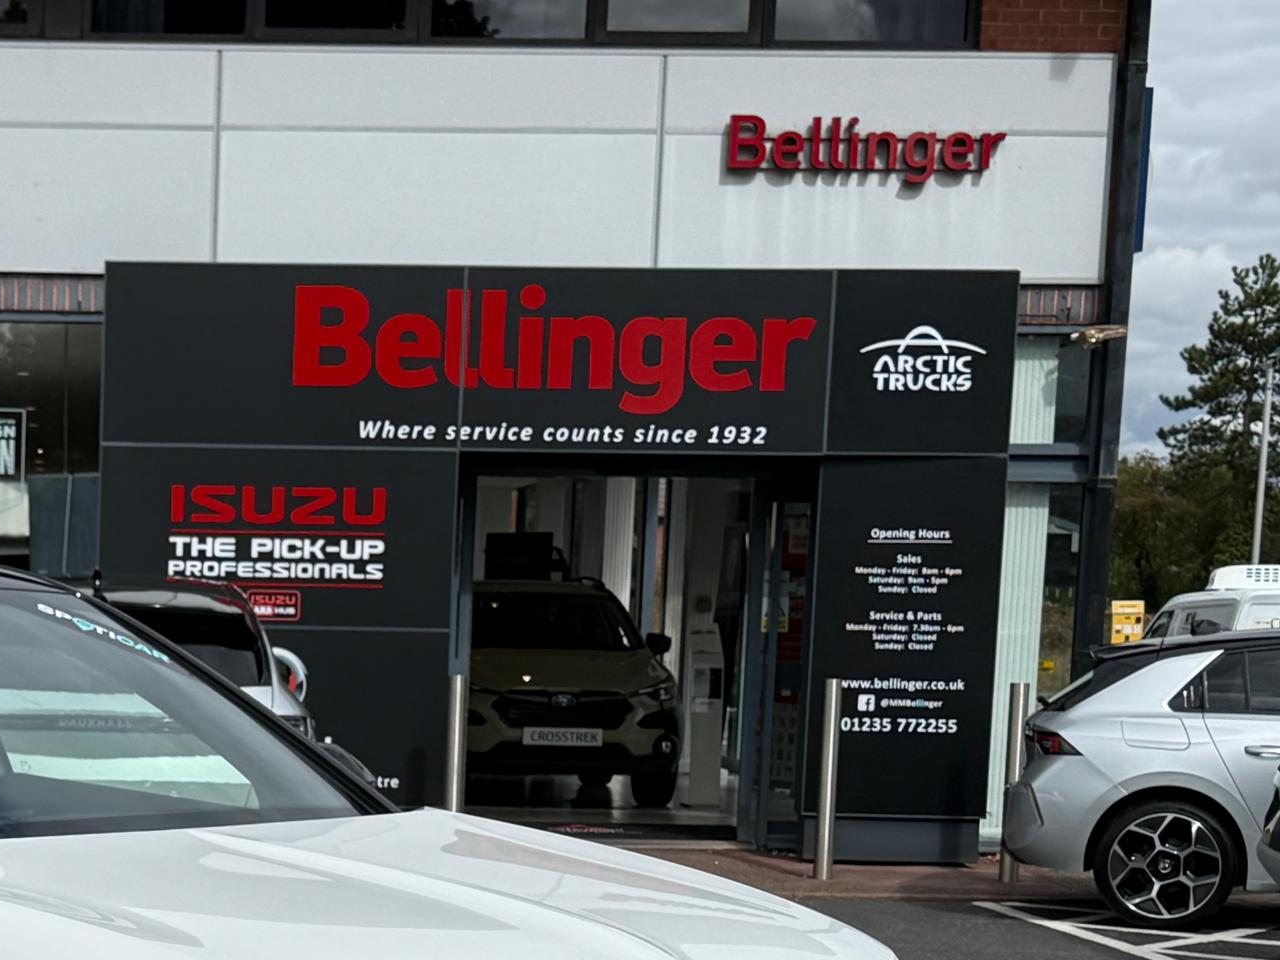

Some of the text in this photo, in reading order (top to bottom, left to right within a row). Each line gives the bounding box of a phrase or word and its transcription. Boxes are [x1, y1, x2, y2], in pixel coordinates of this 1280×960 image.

[726, 114, 1007, 183] Bellinger
[292, 284, 816, 415] Bellinger
[873, 354, 972, 373] ARCTIC
[872, 373, 972, 392] TRUCKS
[359, 420, 767, 445] Where service counts since 1932
[171, 484, 387, 526] ISUZU
[870, 527, 951, 540] Opening Hours
[169, 536, 386, 560] THE PICK-UP
[896, 553, 922, 564] Sales
[167, 560, 384, 580] PROFESSIONALS
[855, 566, 886, 575] Monday
[911, 586, 938, 594] Closed
[251, 594, 296, 605] ISUZU
[869, 610, 942, 621] Service & Parts
[845, 623, 877, 632] Monday
[911, 633, 938, 642] Closed
[907, 642, 934, 651] Closed
[840, 677, 965, 692] www.bellinger.co.uk
[840, 717, 958, 733] 01235 772255
[530, 730, 598, 743] CROSSTREK
